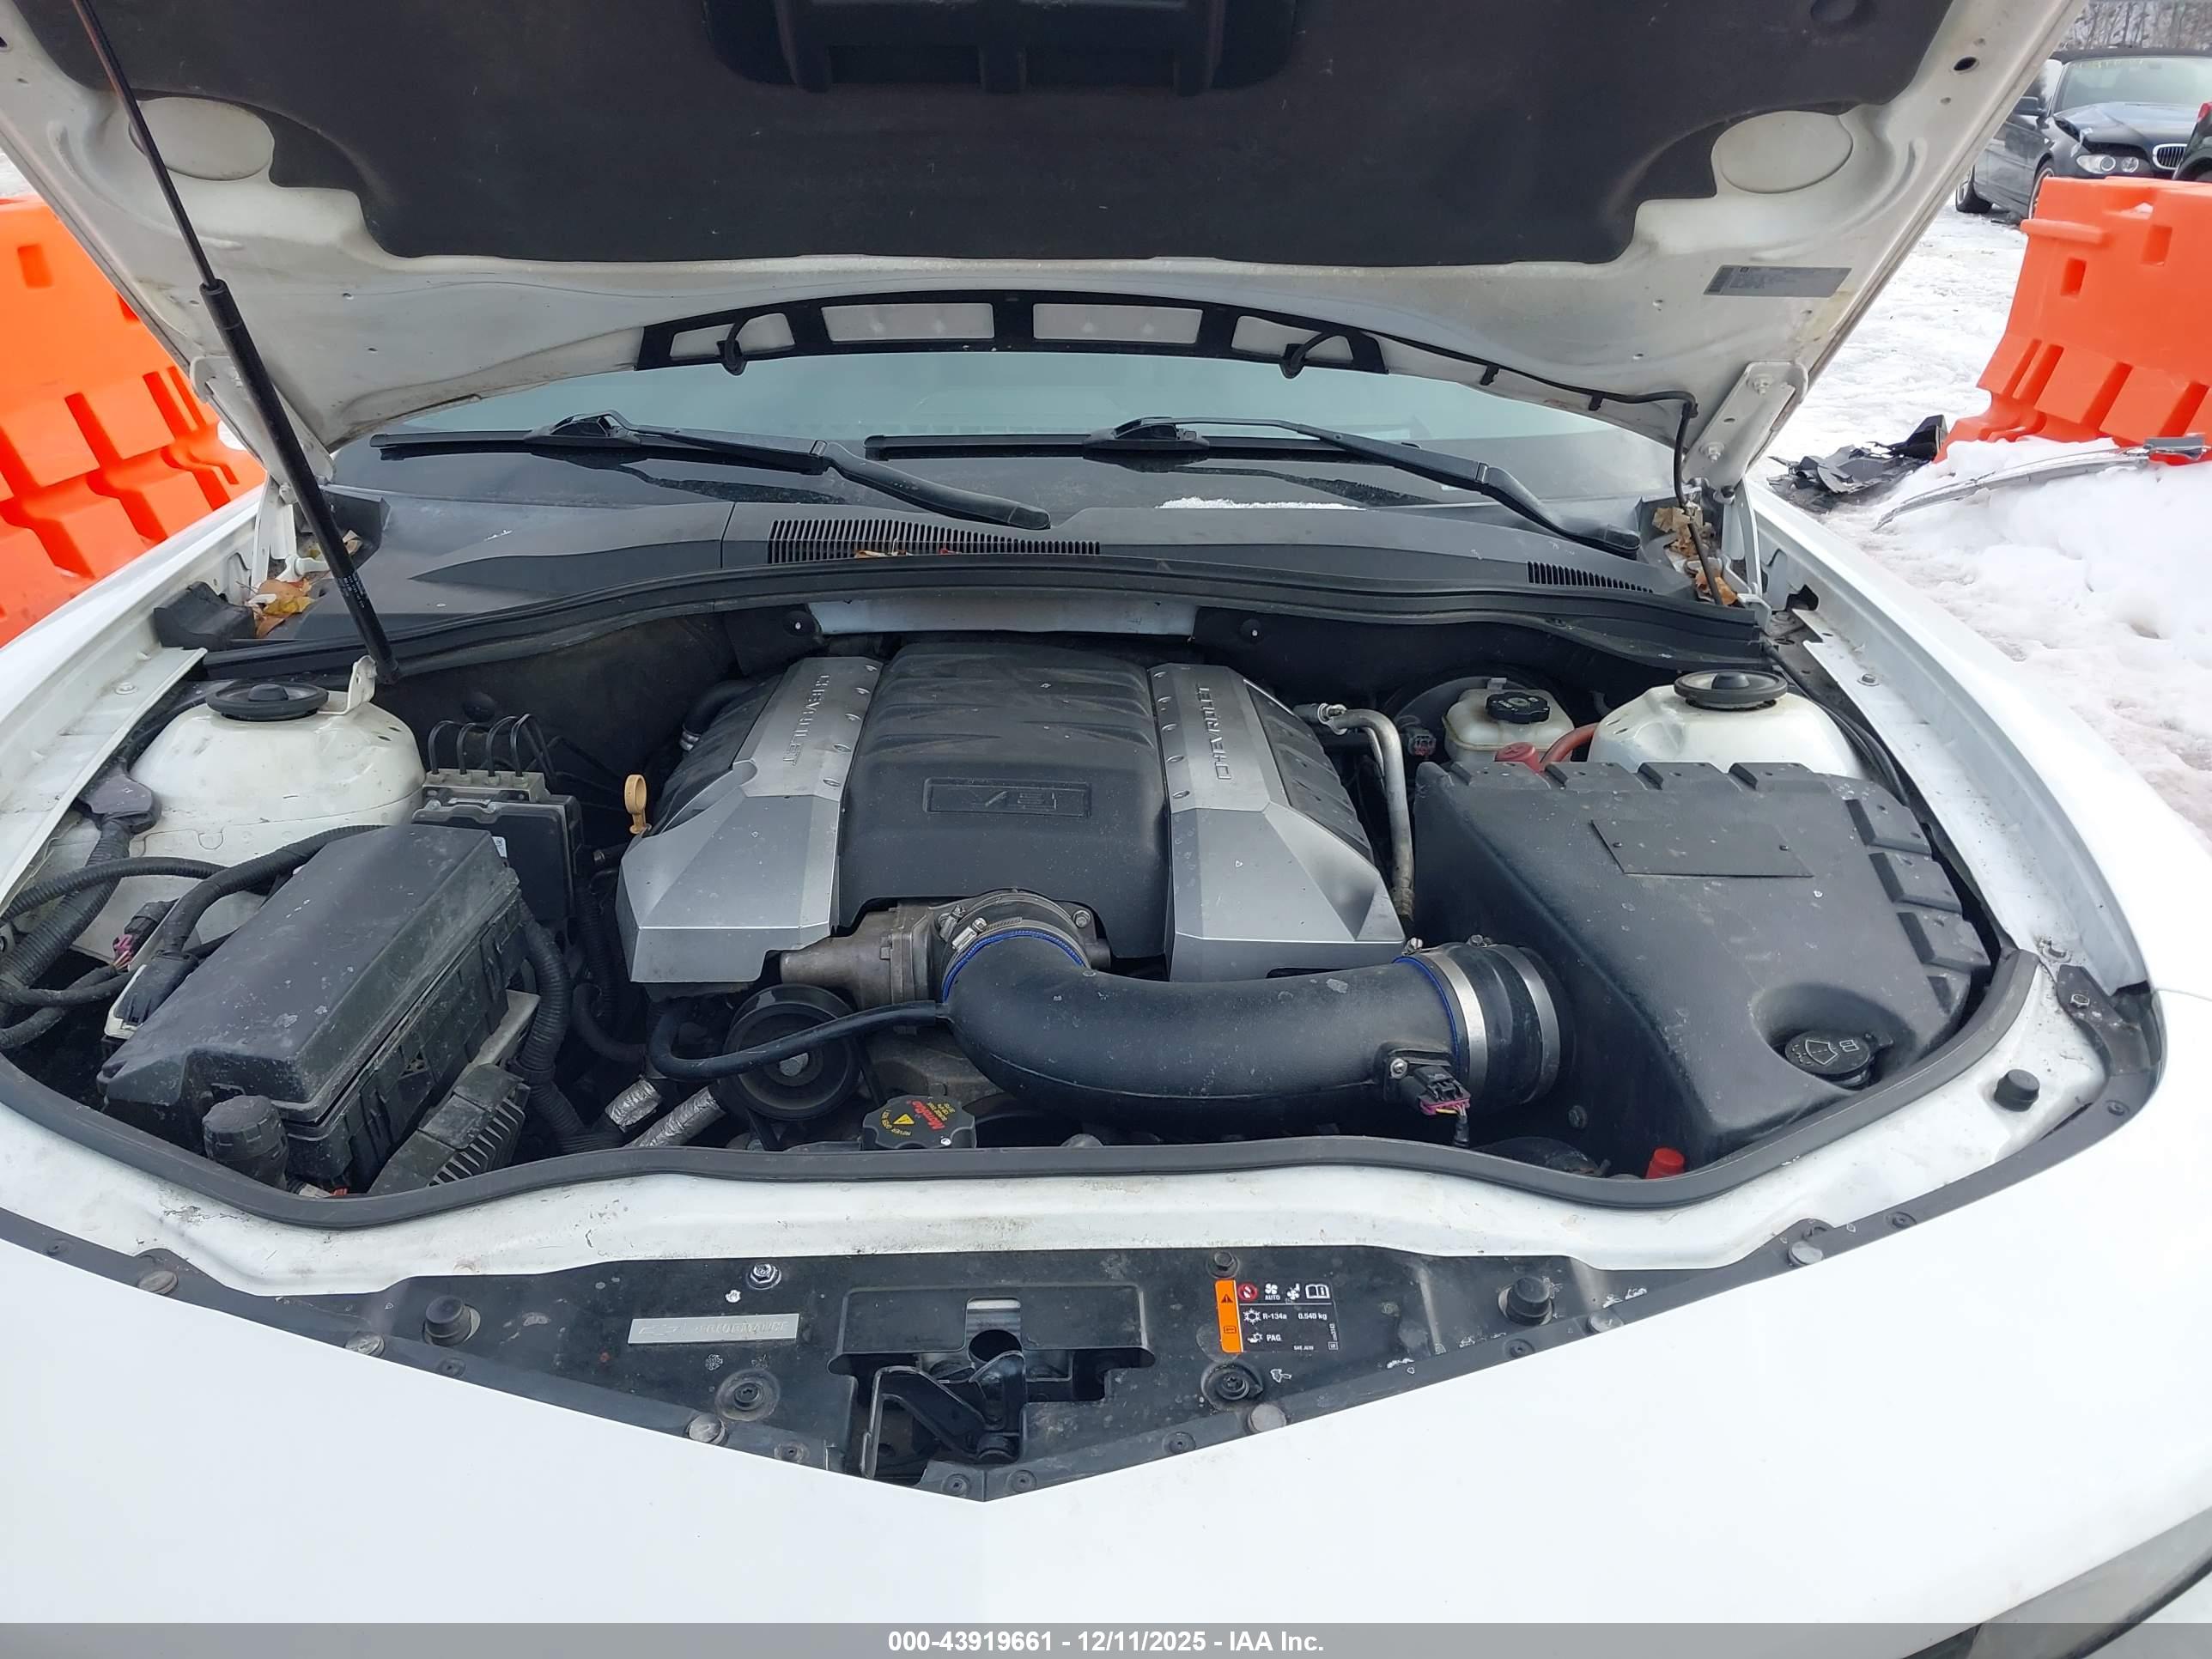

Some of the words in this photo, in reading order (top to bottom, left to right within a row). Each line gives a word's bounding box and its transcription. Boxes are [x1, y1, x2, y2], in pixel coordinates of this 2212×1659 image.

[1196, 684, 1232, 780] CHEVROLET
[1317, 1312, 1328, 1321] kg
[1266, 1334, 1282, 1342] PAG
